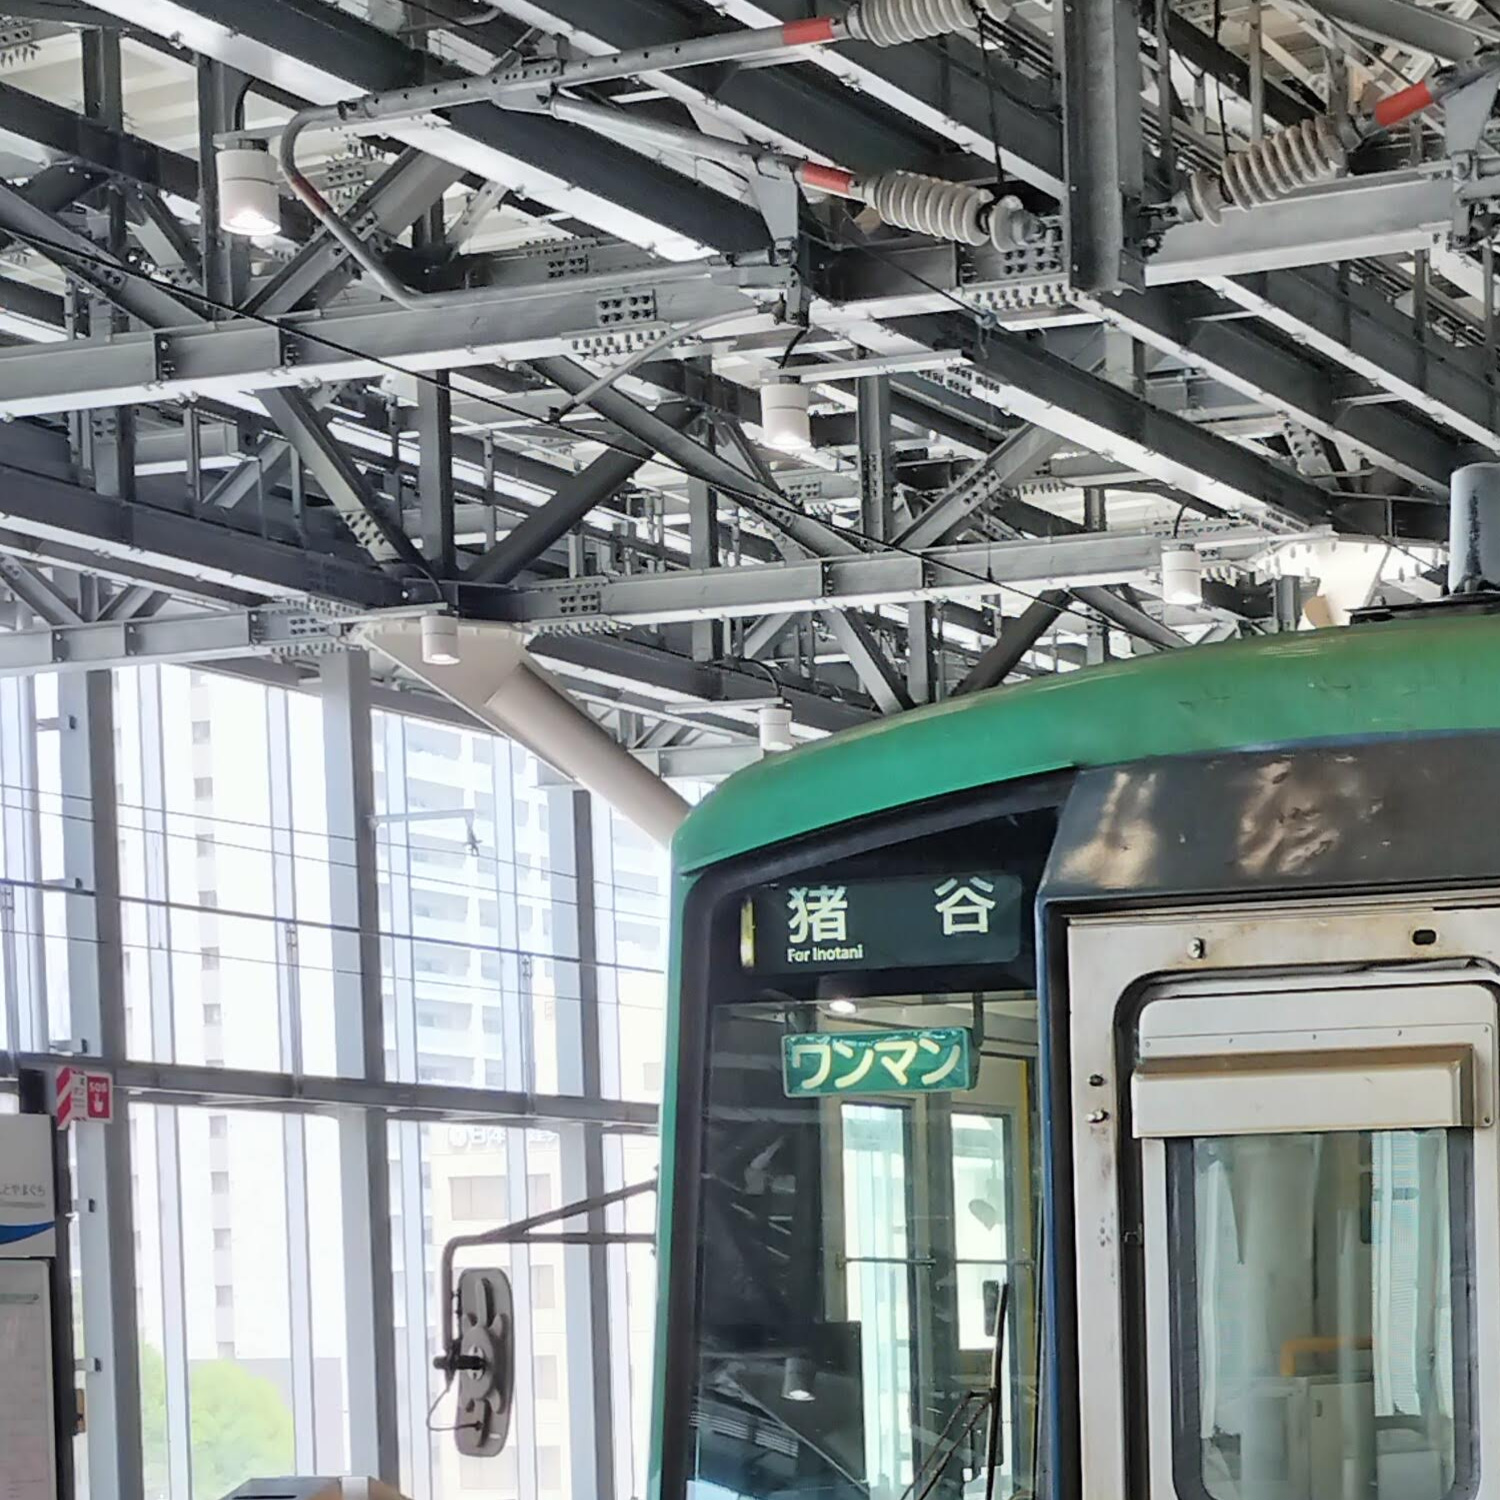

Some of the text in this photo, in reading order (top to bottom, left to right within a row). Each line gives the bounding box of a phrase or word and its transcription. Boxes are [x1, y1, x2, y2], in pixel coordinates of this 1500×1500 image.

[786, 877, 997, 944] 猪谷
[787, 944, 864, 962] For Inotani
[791, 1039, 961, 1090] ワンマン
[0, 1183, 46, 1197] とやまぐち
